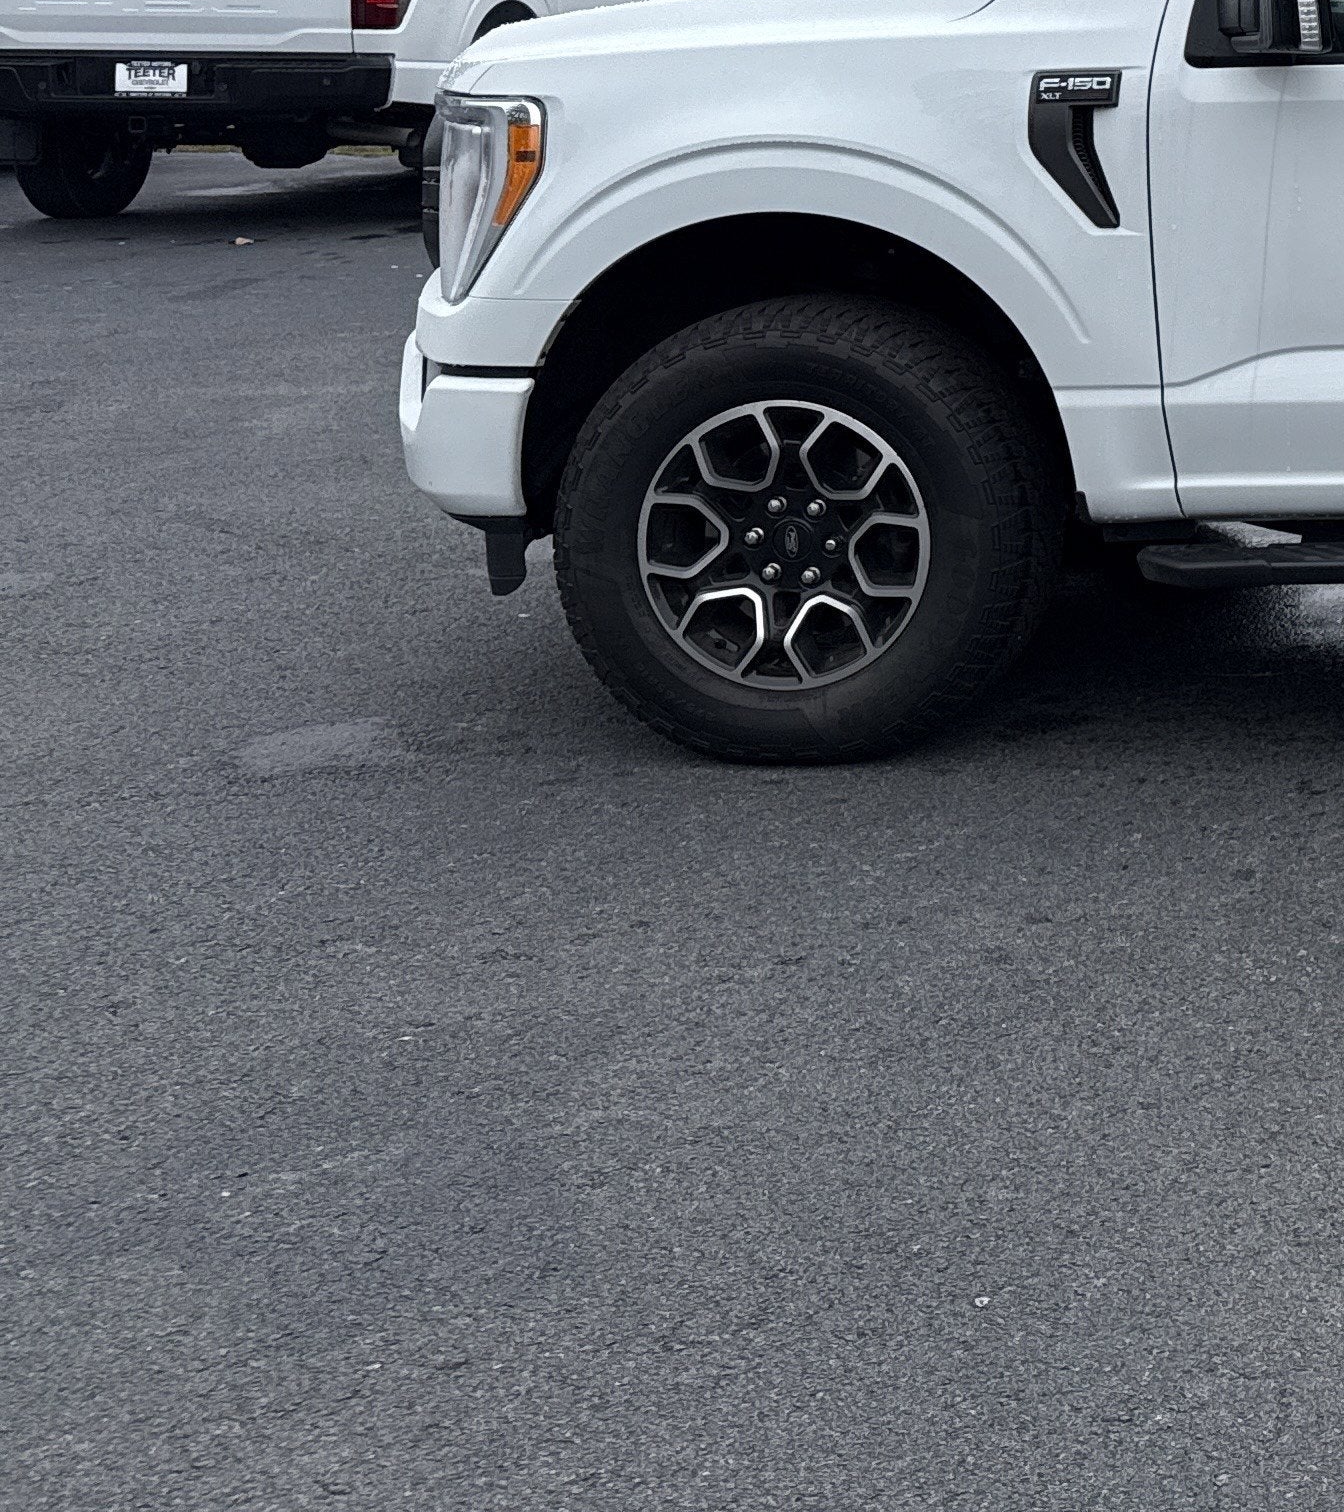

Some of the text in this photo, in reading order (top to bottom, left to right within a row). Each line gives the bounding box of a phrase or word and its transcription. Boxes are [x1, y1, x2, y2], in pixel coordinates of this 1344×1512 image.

[126, 67, 177, 82] TEETER
[1039, 76, 1112, 90] F-150
[1040, 92, 1063, 100] XLT
